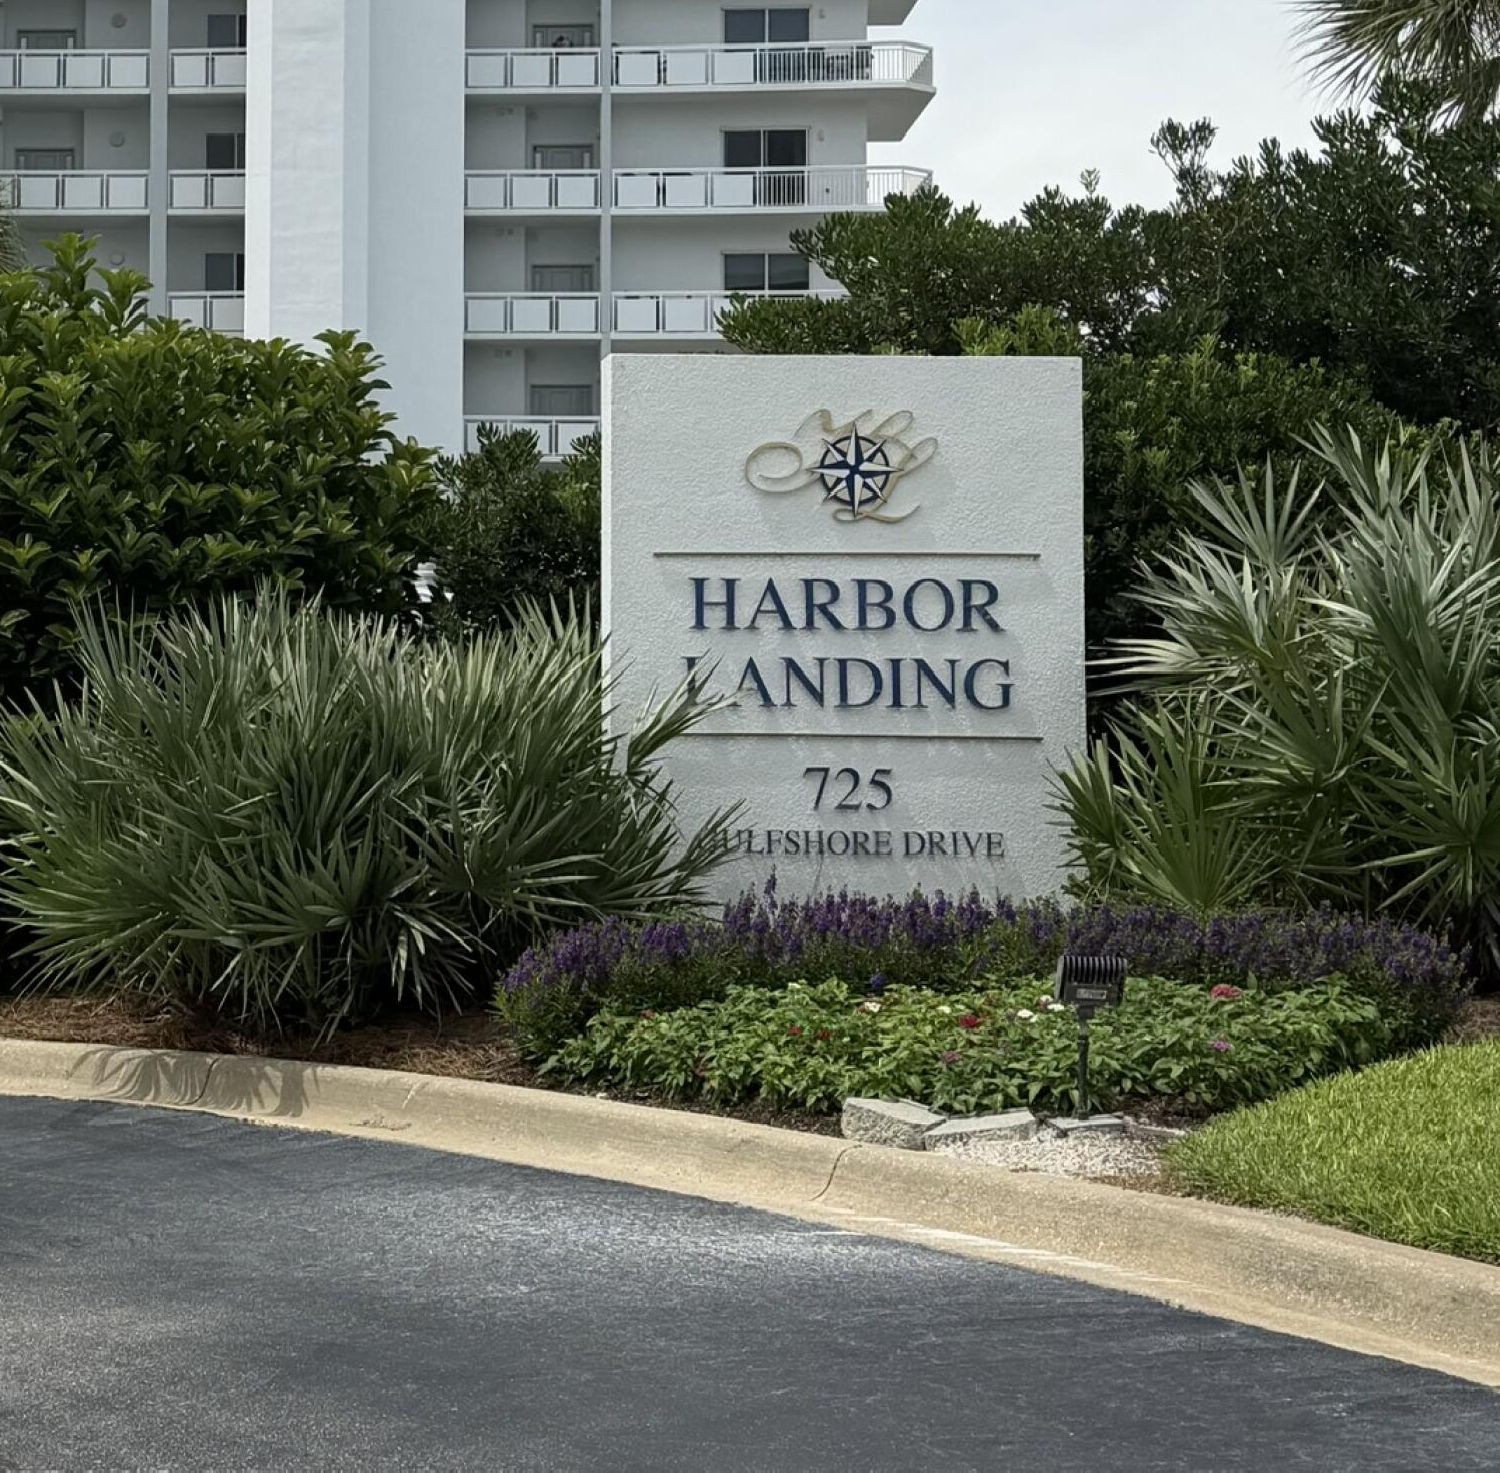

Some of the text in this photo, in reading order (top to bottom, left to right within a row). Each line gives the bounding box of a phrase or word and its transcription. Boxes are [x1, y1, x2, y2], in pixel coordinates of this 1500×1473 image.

[687, 577, 1007, 632] HARBOR
[802, 766, 893, 811] 725
[699, 829, 1005, 858] ULFSHORE DRIVE
